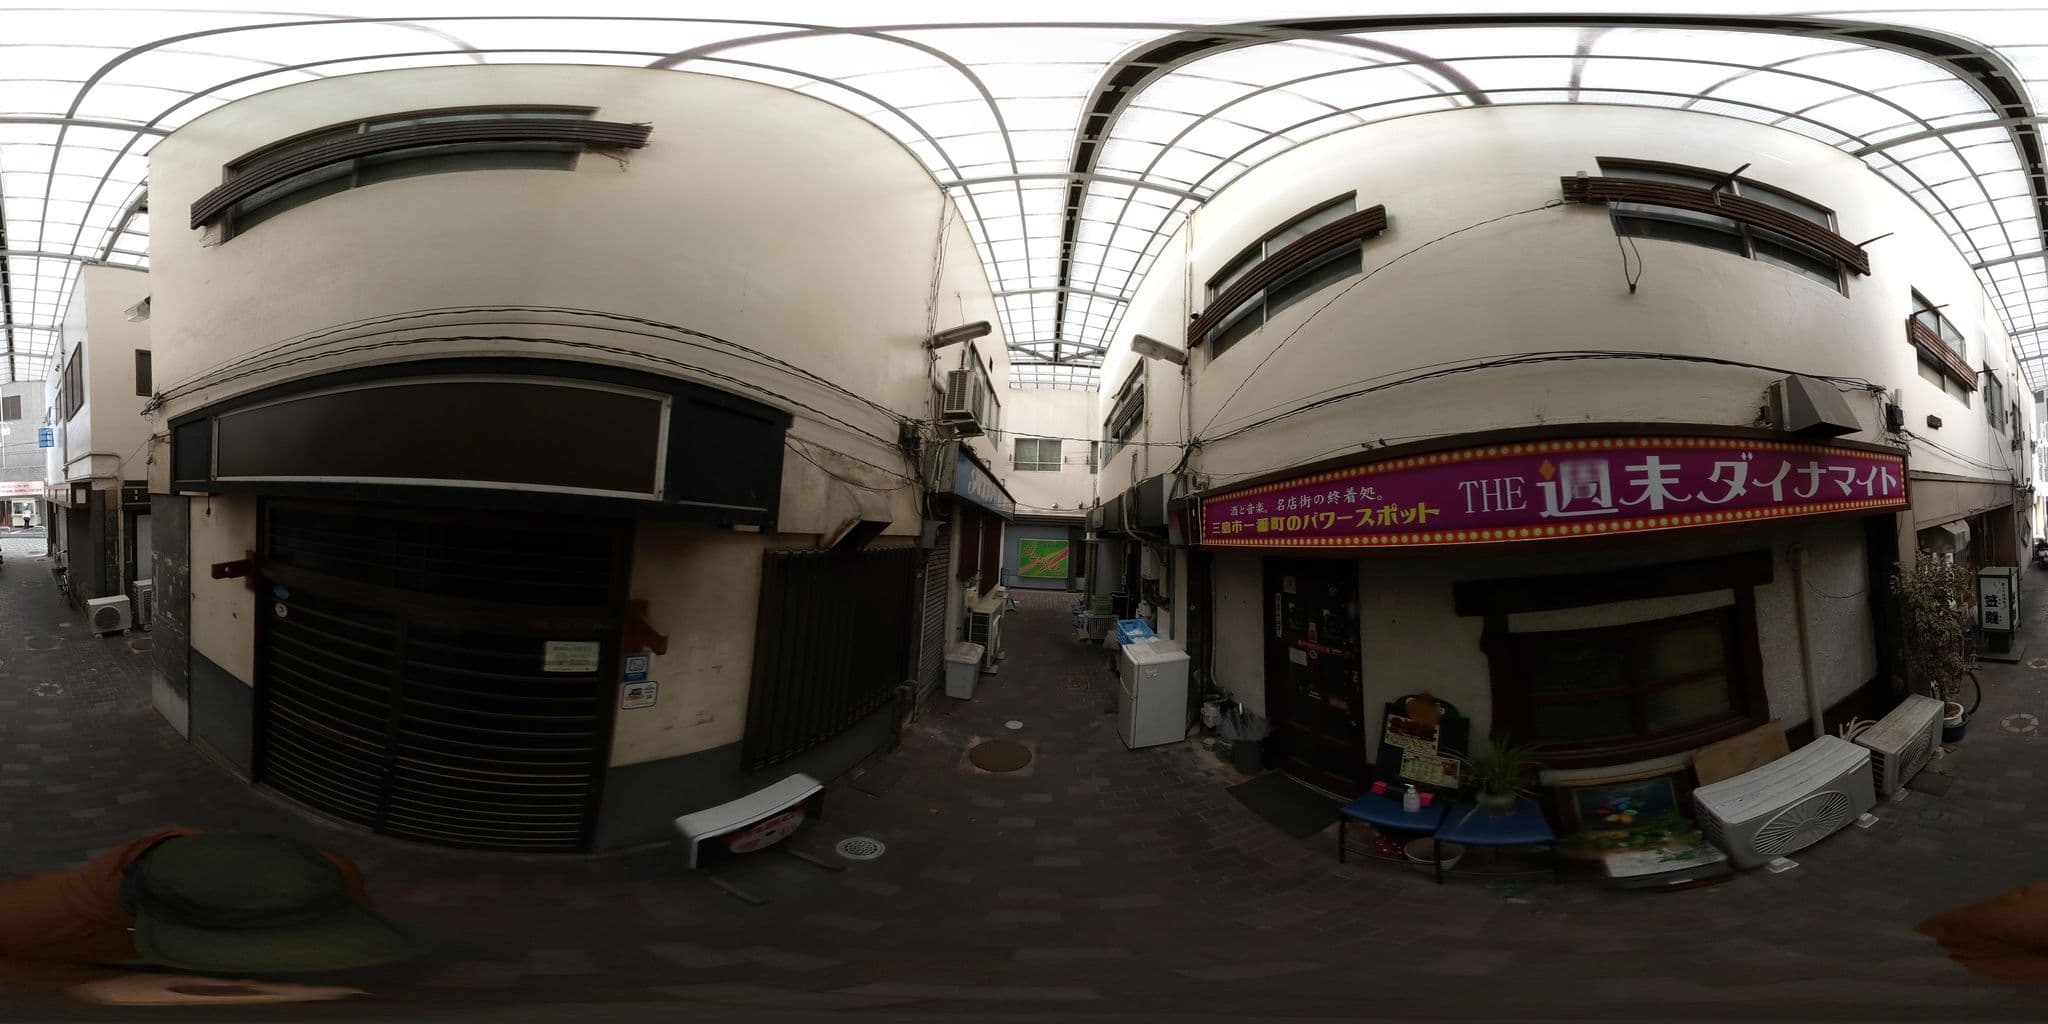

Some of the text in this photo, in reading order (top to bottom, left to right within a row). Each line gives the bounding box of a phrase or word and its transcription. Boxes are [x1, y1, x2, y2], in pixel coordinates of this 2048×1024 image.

[1458, 476, 1528, 514] THE
[1211, 502, 1441, 534] 三島市一番町のパワースポット
